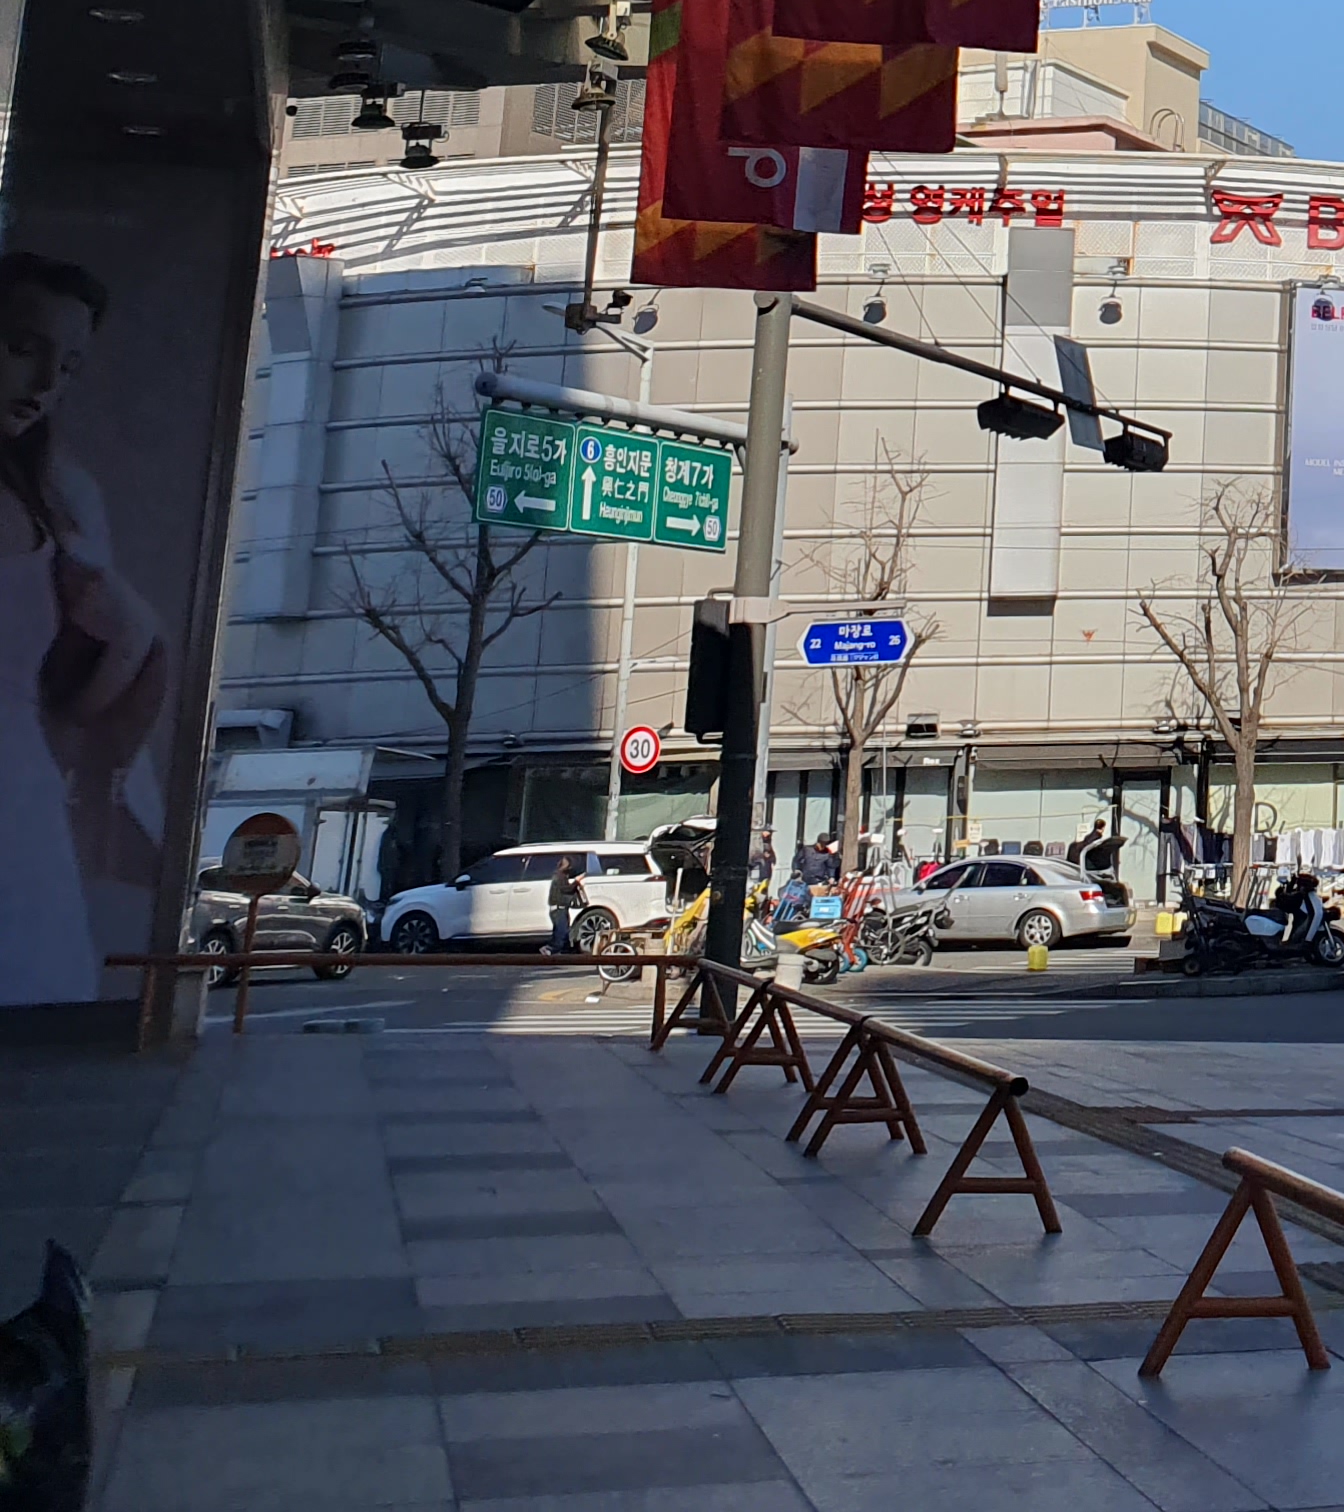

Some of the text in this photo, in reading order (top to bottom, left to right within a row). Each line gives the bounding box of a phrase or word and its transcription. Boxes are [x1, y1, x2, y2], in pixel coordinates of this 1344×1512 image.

[490, 427, 568, 466] 을지로5가
[586, 440, 596, 460] 6
[603, 444, 653, 477] 흥인지문
[664, 457, 715, 489] 청계7가
[488, 490, 505, 509] 50
[706, 520, 719, 535] 50
[838, 624, 873, 638] 마장로
[809, 638, 822, 650] 22
[628, 738, 651, 761] 30
